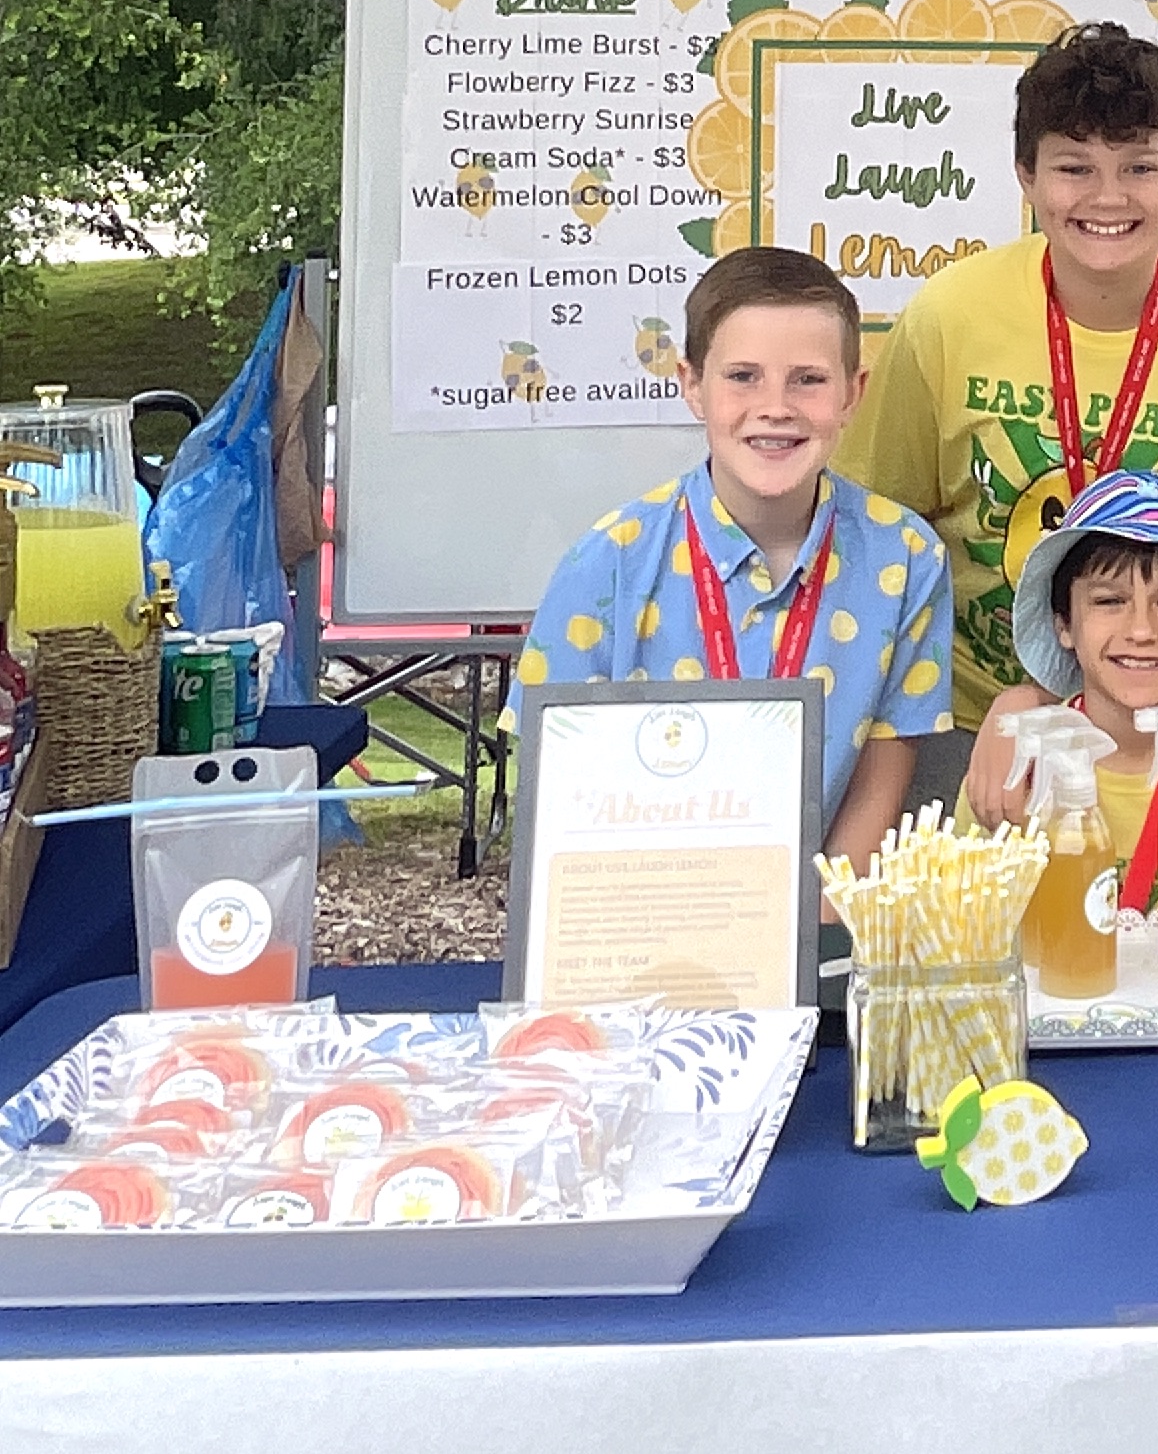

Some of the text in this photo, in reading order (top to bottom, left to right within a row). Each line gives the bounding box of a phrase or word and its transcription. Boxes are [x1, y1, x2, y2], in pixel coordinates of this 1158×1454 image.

[424, 33, 512, 60] Cherry
[522, 33, 583, 55] Lime
[593, 34, 660, 55] Burst
[448, 71, 574, 97] Flowberry
[584, 71, 636, 94] Fizz
[663, 71, 694, 94] $3
[851, 82, 951, 129] Live
[442, 108, 694, 135] Strawberry Sunrise
[450, 148, 537, 169] Cream
[652, 146, 686, 169] $3
[824, 150, 975, 208] Laugh
[412, 184, 722, 207] Watermelon Cool Down
[560, 223, 593, 245] $3
[428, 268, 518, 289] Frozen
[529, 265, 617, 288] Lemon
[628, 263, 687, 286] Dots
[551, 303, 583, 326] $2
[525, 380, 577, 403] free
[586, 377, 680, 402] availab
[965, 376, 1058, 421] EAS
[593, 789, 750, 825] About Us
